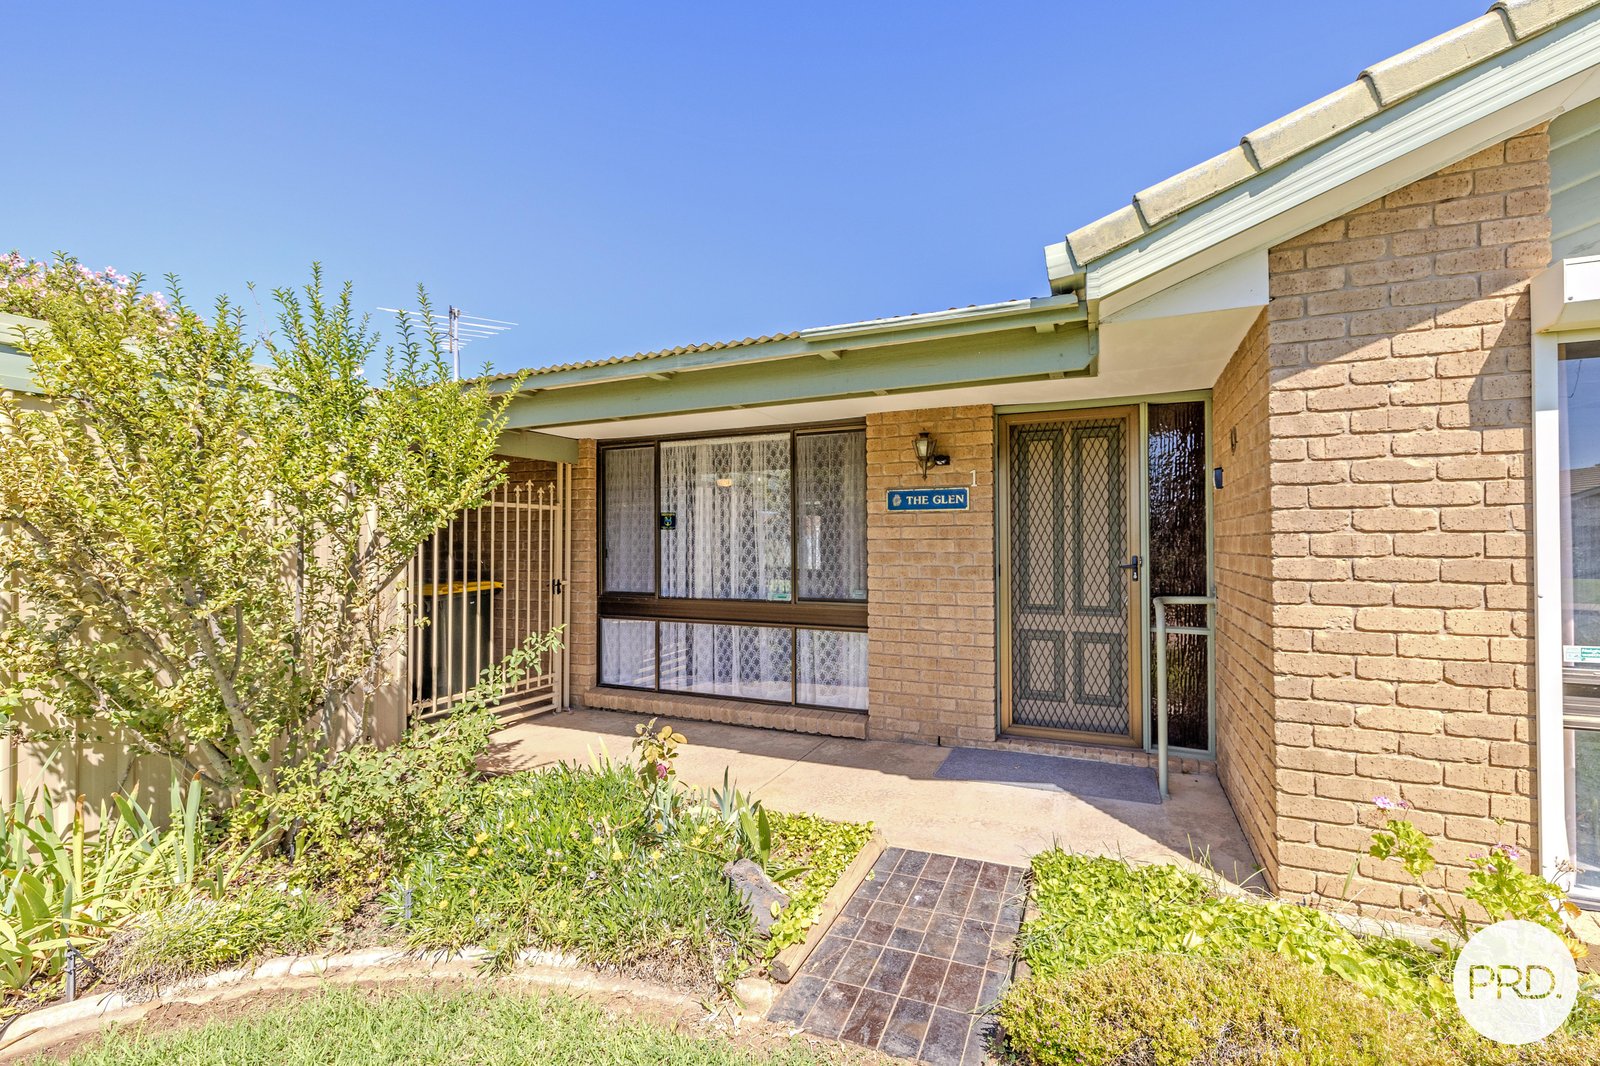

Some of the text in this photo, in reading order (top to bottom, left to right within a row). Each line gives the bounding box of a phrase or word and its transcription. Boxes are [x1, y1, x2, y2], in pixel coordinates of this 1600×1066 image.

[969, 469, 978, 487] 1
[906, 494, 964, 505] THE GLEN
